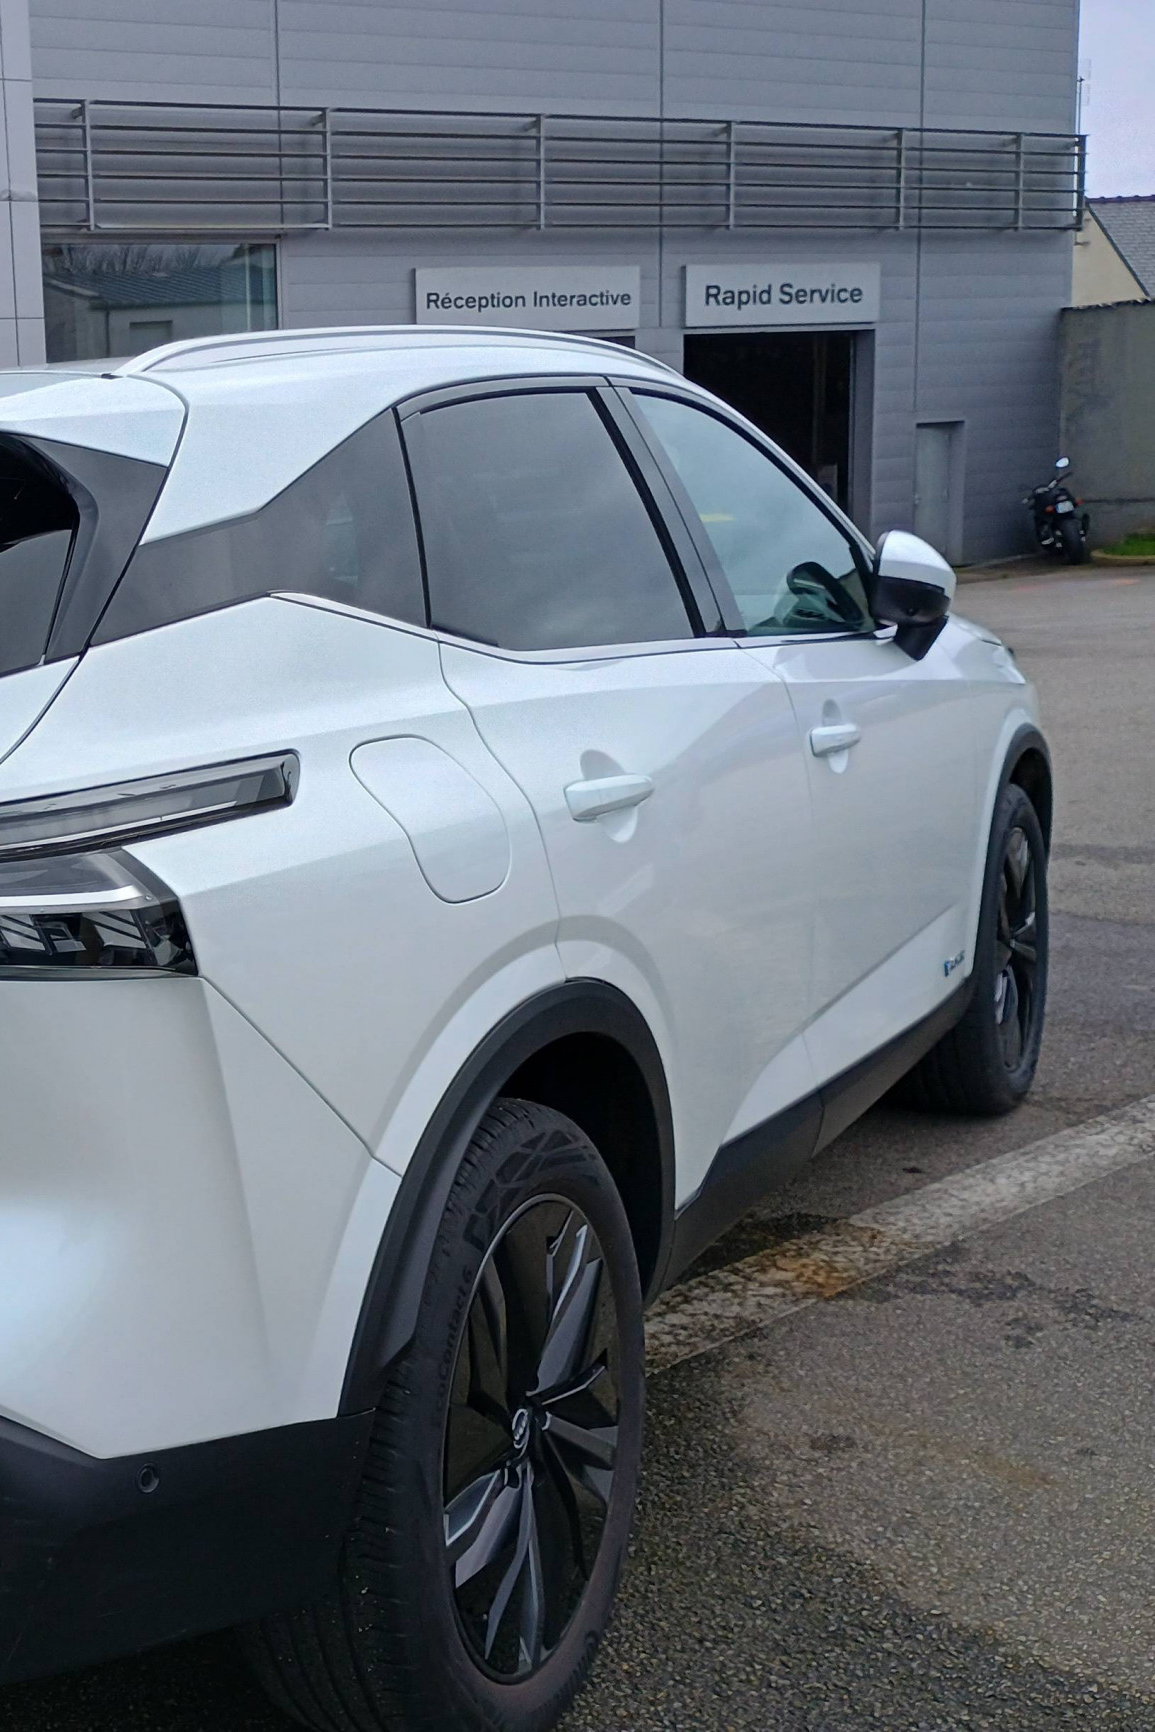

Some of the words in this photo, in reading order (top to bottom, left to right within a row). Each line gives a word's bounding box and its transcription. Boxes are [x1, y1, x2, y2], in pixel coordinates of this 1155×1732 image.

[426, 292, 526, 313] Réception
[533, 290, 632, 308] Interactive
[704, 284, 772, 310] Rapid
[779, 283, 863, 305] Service
